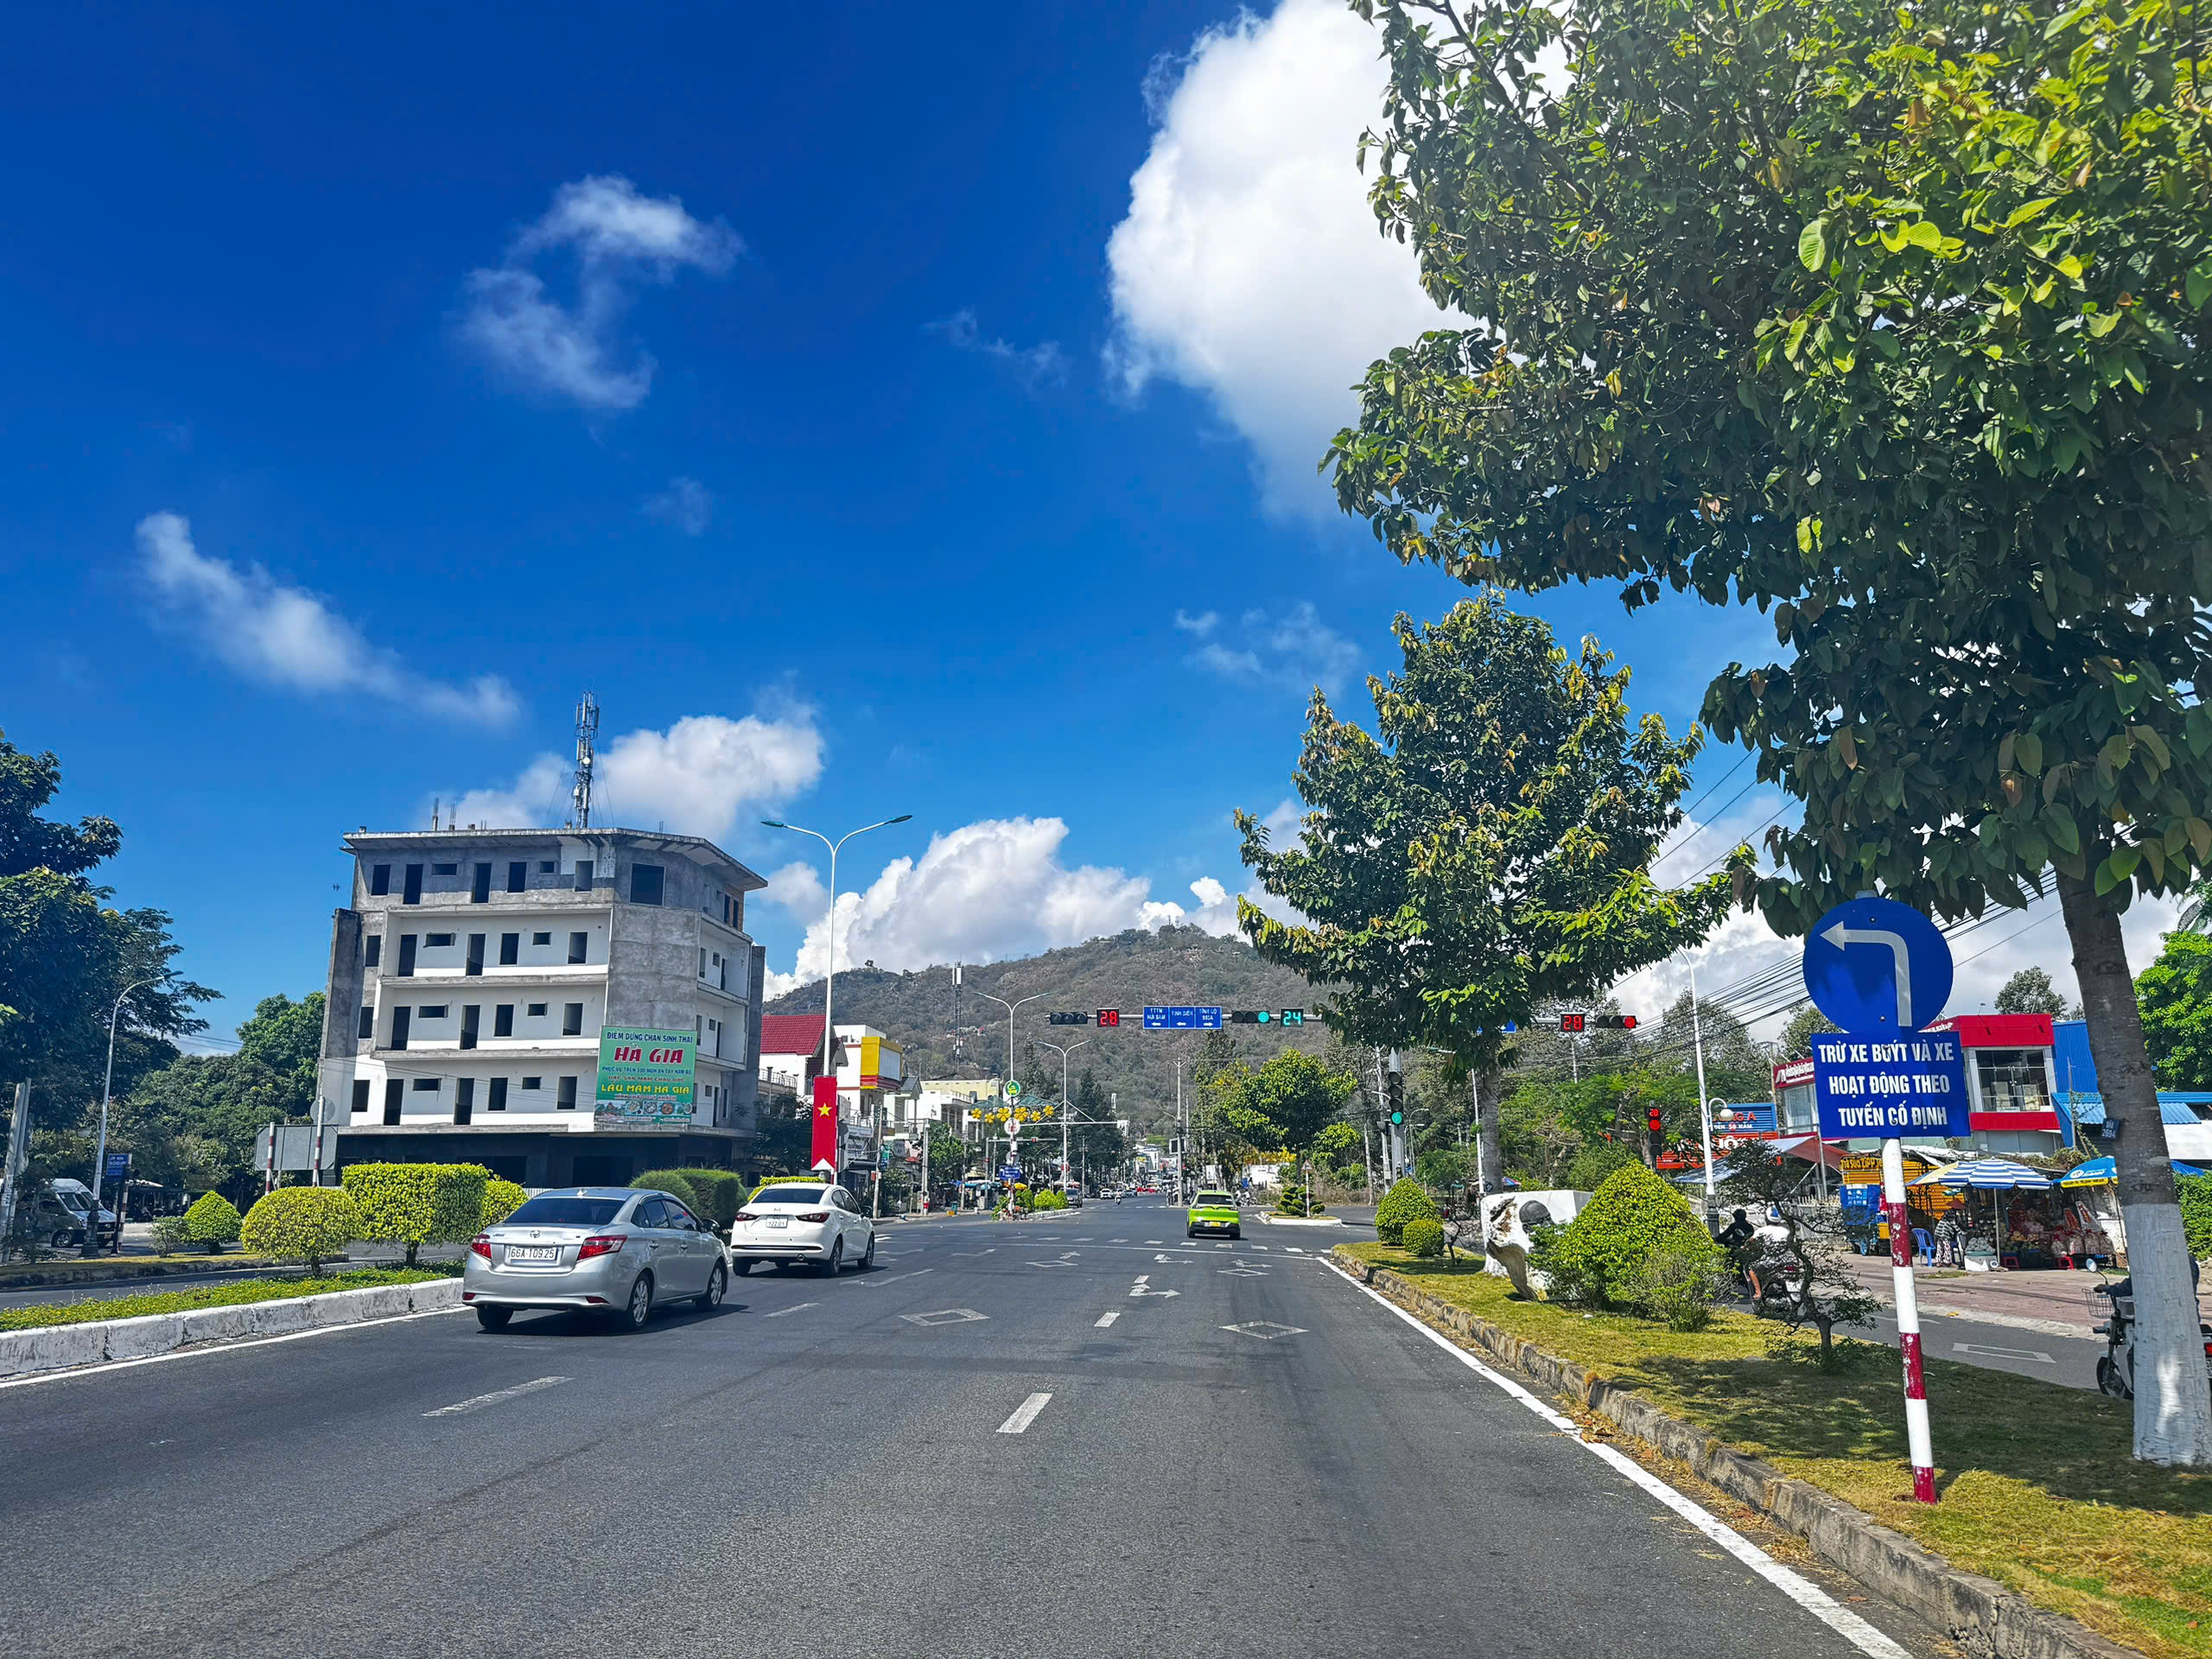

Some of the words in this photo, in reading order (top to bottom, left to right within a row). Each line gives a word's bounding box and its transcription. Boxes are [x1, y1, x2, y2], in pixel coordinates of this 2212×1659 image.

[1101, 1011, 1117, 1026] 28
[1284, 1011, 1300, 1026] 24
[1563, 1015, 1582, 1030] 28
[663, 1035, 677, 1044] SINH
[648, 1048, 684, 1065] GIA
[1818, 1040, 1847, 1063] TRỪ
[1849, 1045, 1868, 1063] XE
[1911, 1039, 1931, 1062] VÀ
[1934, 1042, 1955, 1061] XE
[672, 1086, 690, 1095] GIA
[1828, 1076, 1866, 1098] HOẠT
[1869, 1071, 1910, 1098] ĐỘNG
[1912, 1075, 1950, 1093] THEO
[1838, 1102, 1885, 1126] TUYẾN
[1887, 1100, 1908, 1126] CỐ
[1911, 1107, 1948, 1128] ĐỊNH
[511, 1248, 554, 1258] 66A-109.25
